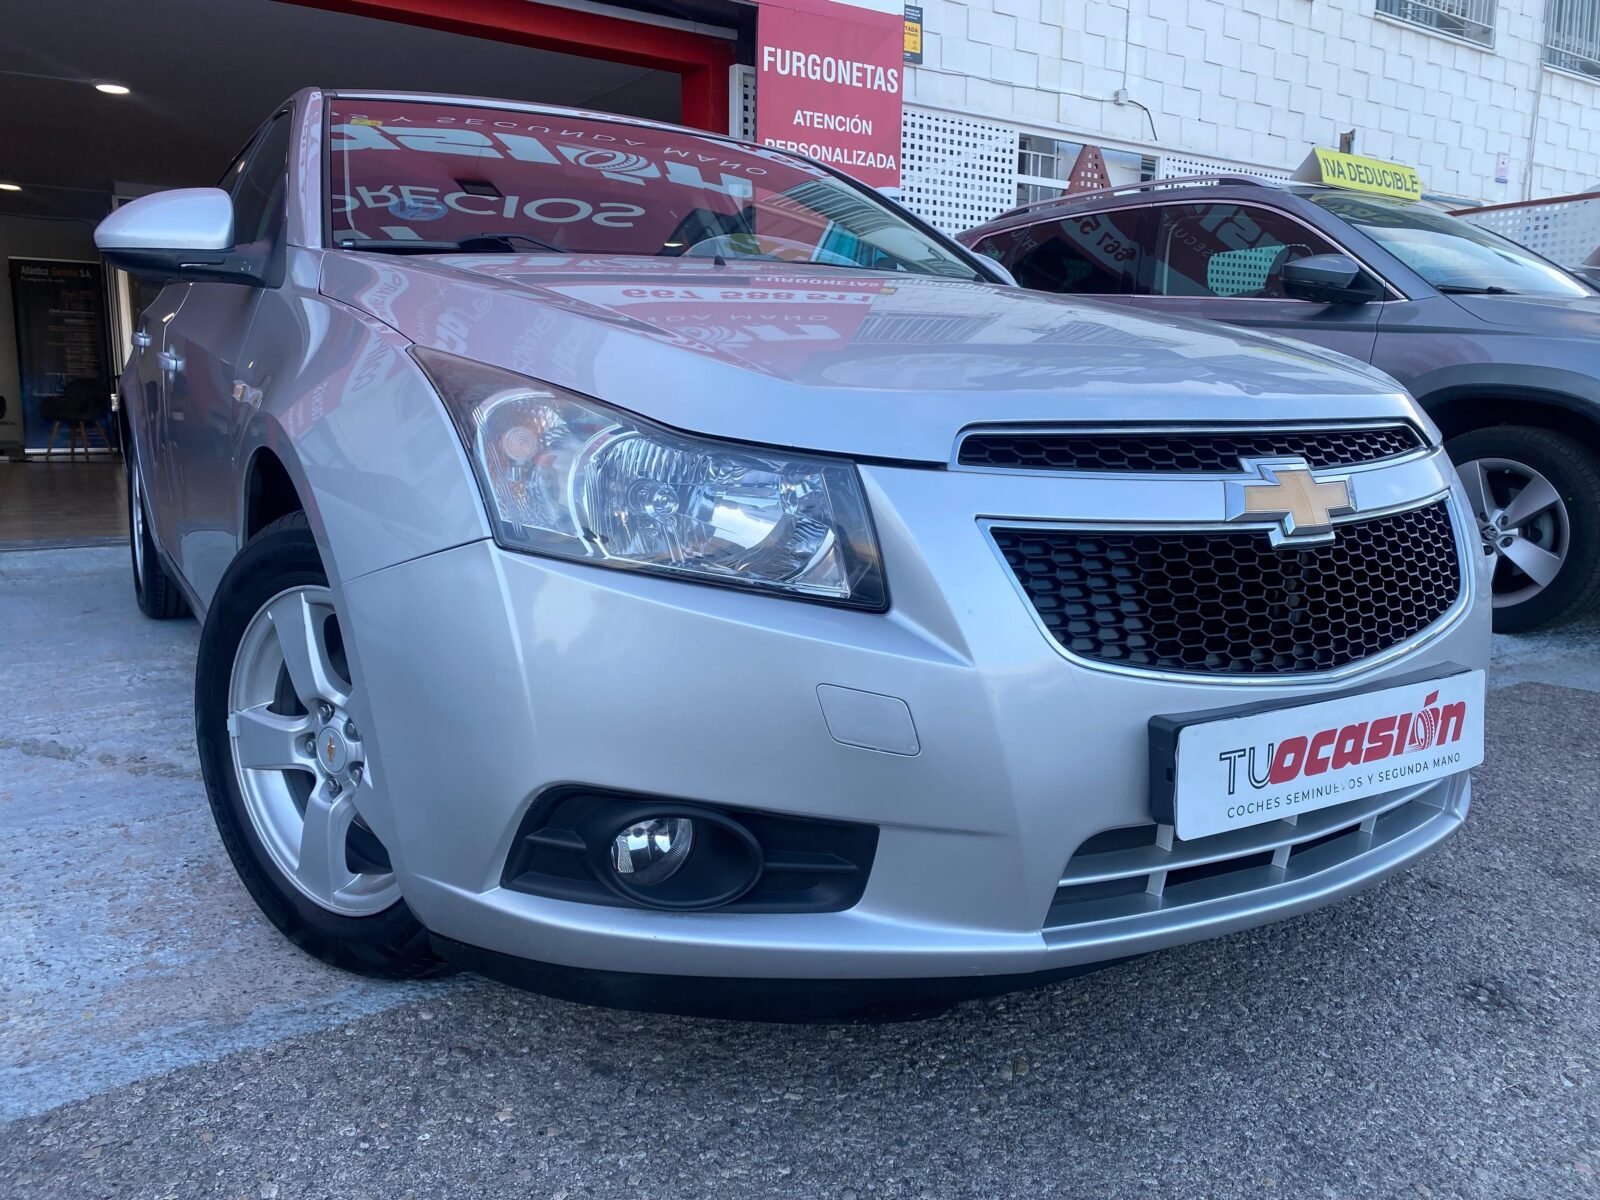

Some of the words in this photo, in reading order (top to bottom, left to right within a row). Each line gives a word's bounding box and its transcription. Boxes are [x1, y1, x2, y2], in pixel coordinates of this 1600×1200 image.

[763, 46, 898, 93] FURGONETAS
[793, 109, 872, 135] ATENCIÓN
[764, 138, 897, 170] PERSONALIZADA
[1322, 157, 1346, 180] IVA
[1346, 162, 1418, 193] DEDUCIBLE
[1227, 796, 1281, 819] COCHES
[1367, 774, 1374, 785] Y
[1378, 761, 1428, 783] SEGUNDA
[1433, 752, 1461, 768] MANO
